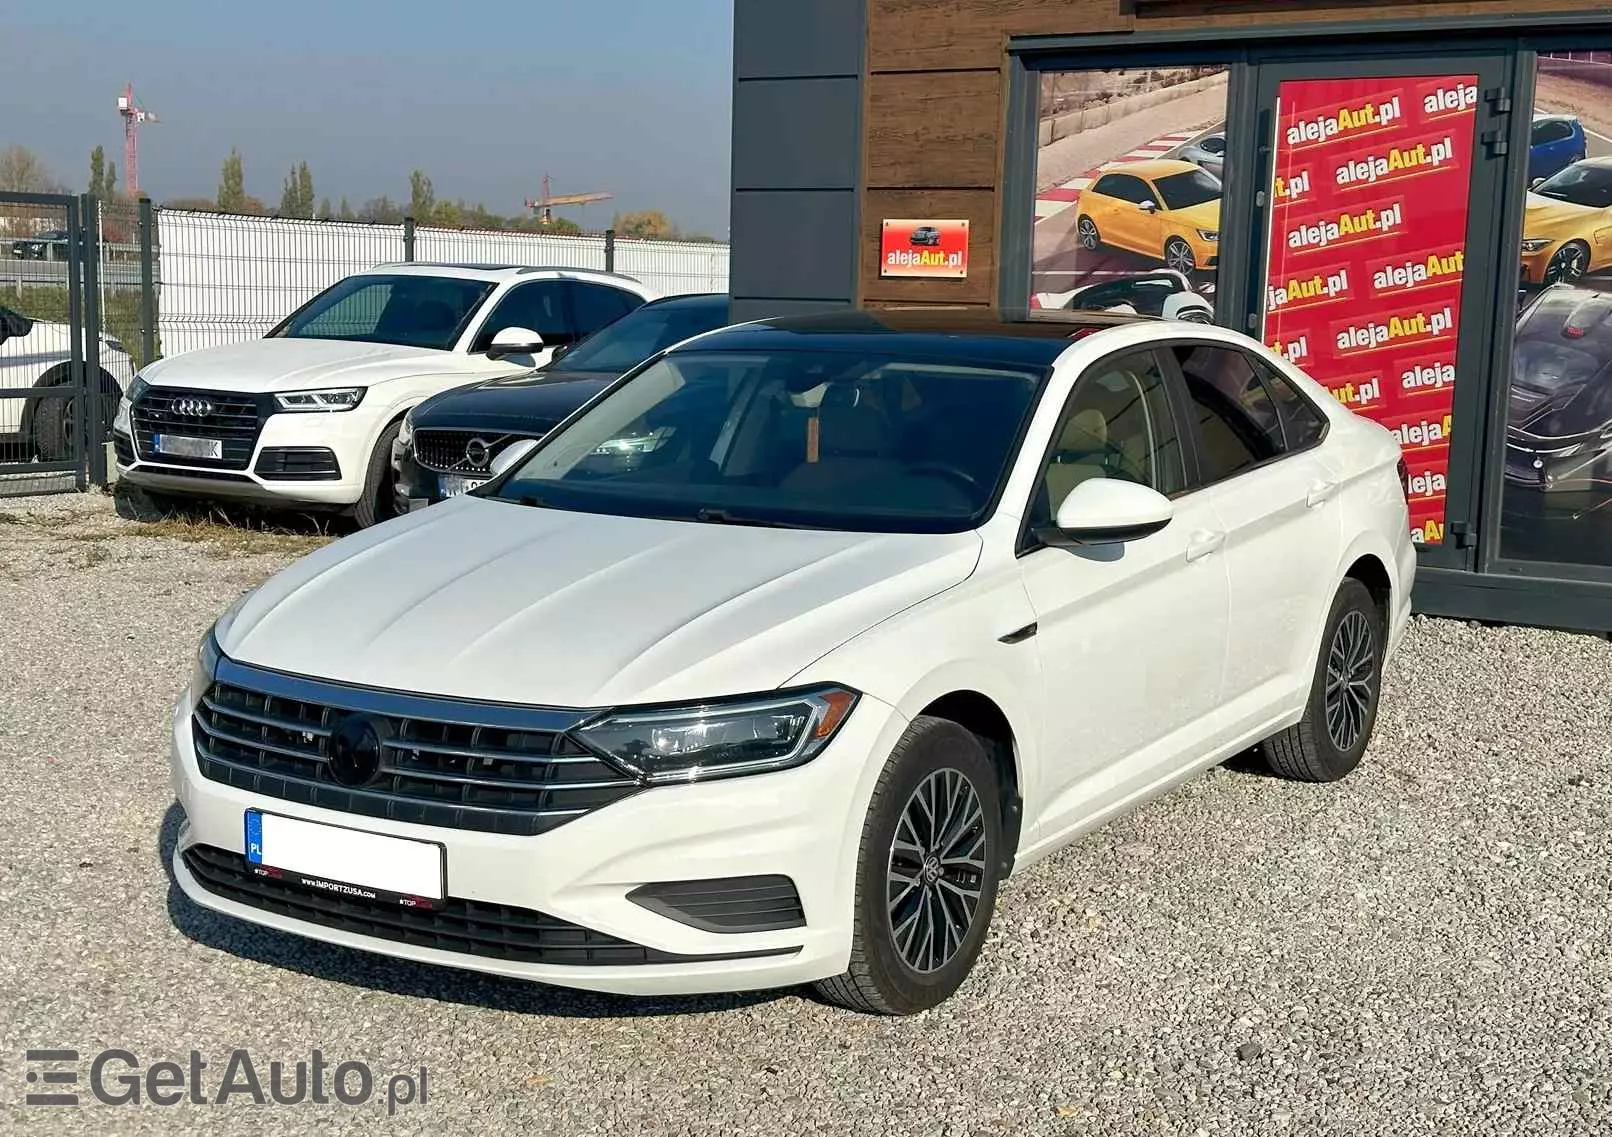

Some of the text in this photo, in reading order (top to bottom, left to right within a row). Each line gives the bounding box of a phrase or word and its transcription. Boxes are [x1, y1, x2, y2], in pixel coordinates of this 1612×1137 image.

[1286, 96, 1401, 145] alejaAut.pl
[1335, 137, 1453, 185] alejaAut.pl
[1288, 203, 1402, 248] alejaAut.pl
[888, 249, 963, 268] alejaAut.pl
[1336, 307, 1453, 349] alejaAut.pl
[250, 842, 262, 856] PL
